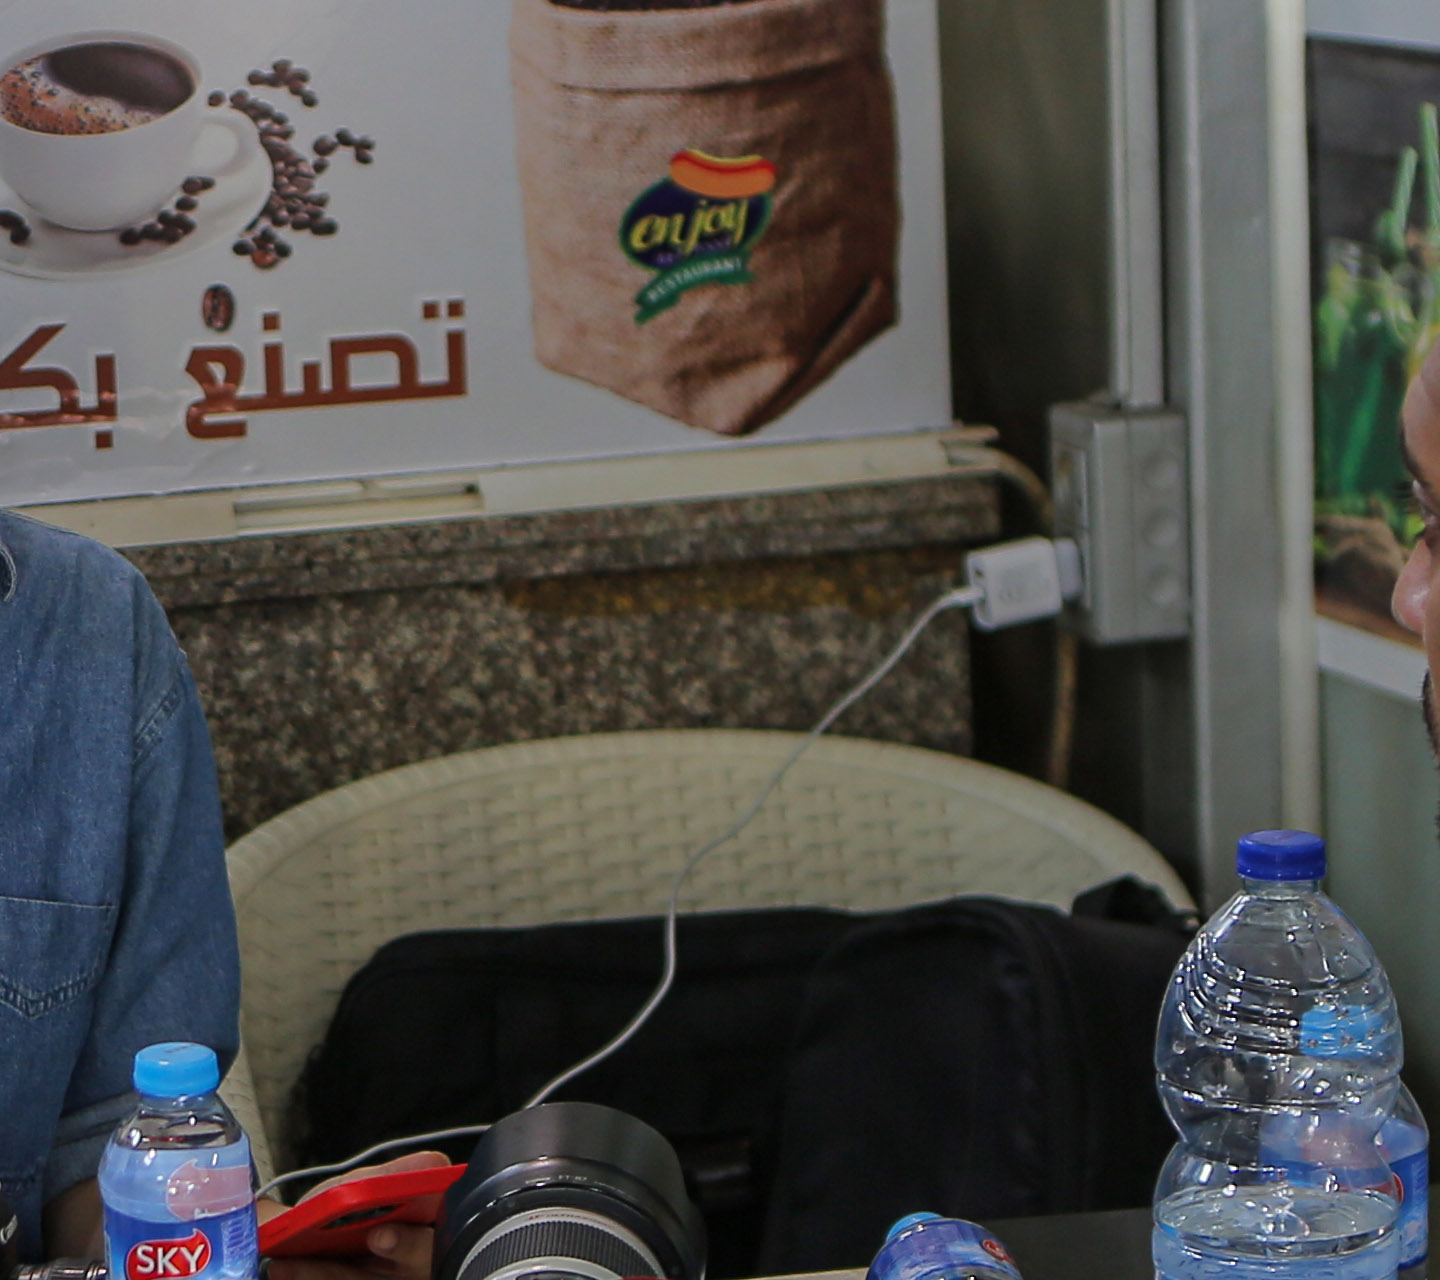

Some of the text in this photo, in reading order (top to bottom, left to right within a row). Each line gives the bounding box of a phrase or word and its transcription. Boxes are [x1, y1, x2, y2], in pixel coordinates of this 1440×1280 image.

[629, 199, 750, 256] enjoy
[185, 298, 468, 439] تصنع
[136, 1242, 206, 1275] SKY
